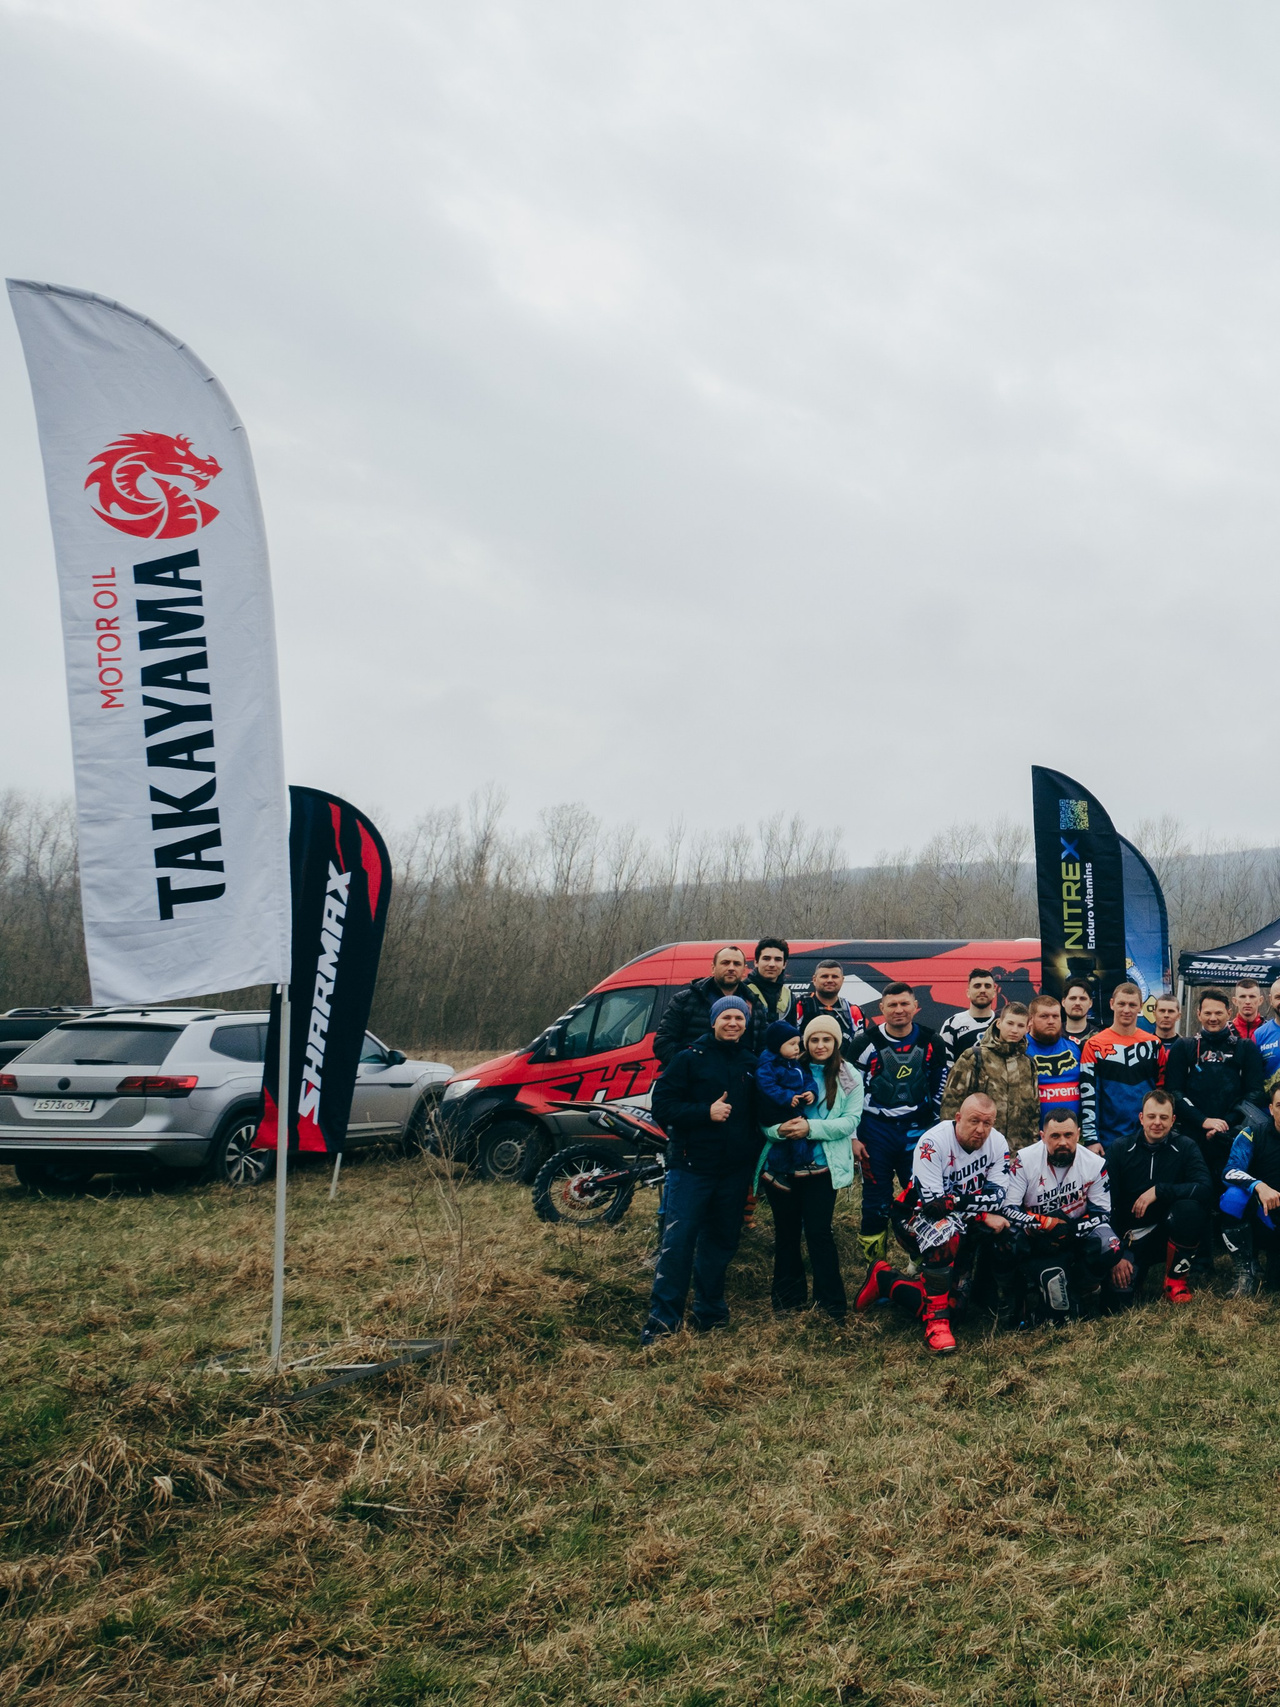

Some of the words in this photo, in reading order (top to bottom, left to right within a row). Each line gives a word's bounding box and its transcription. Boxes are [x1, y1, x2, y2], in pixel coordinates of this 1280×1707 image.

[92, 567, 118, 610] OIL
[95, 616, 125, 709] MOTOR
[133, 548, 226, 921] TAKAYAMA
[1060, 836, 1084, 950] NITREX
[1083, 862, 1094, 908] vitamins
[1086, 910, 1095, 950] Enduro
[298, 860, 352, 1125] SHARMAX
[1189, 961, 1272, 973] SHARMAX
